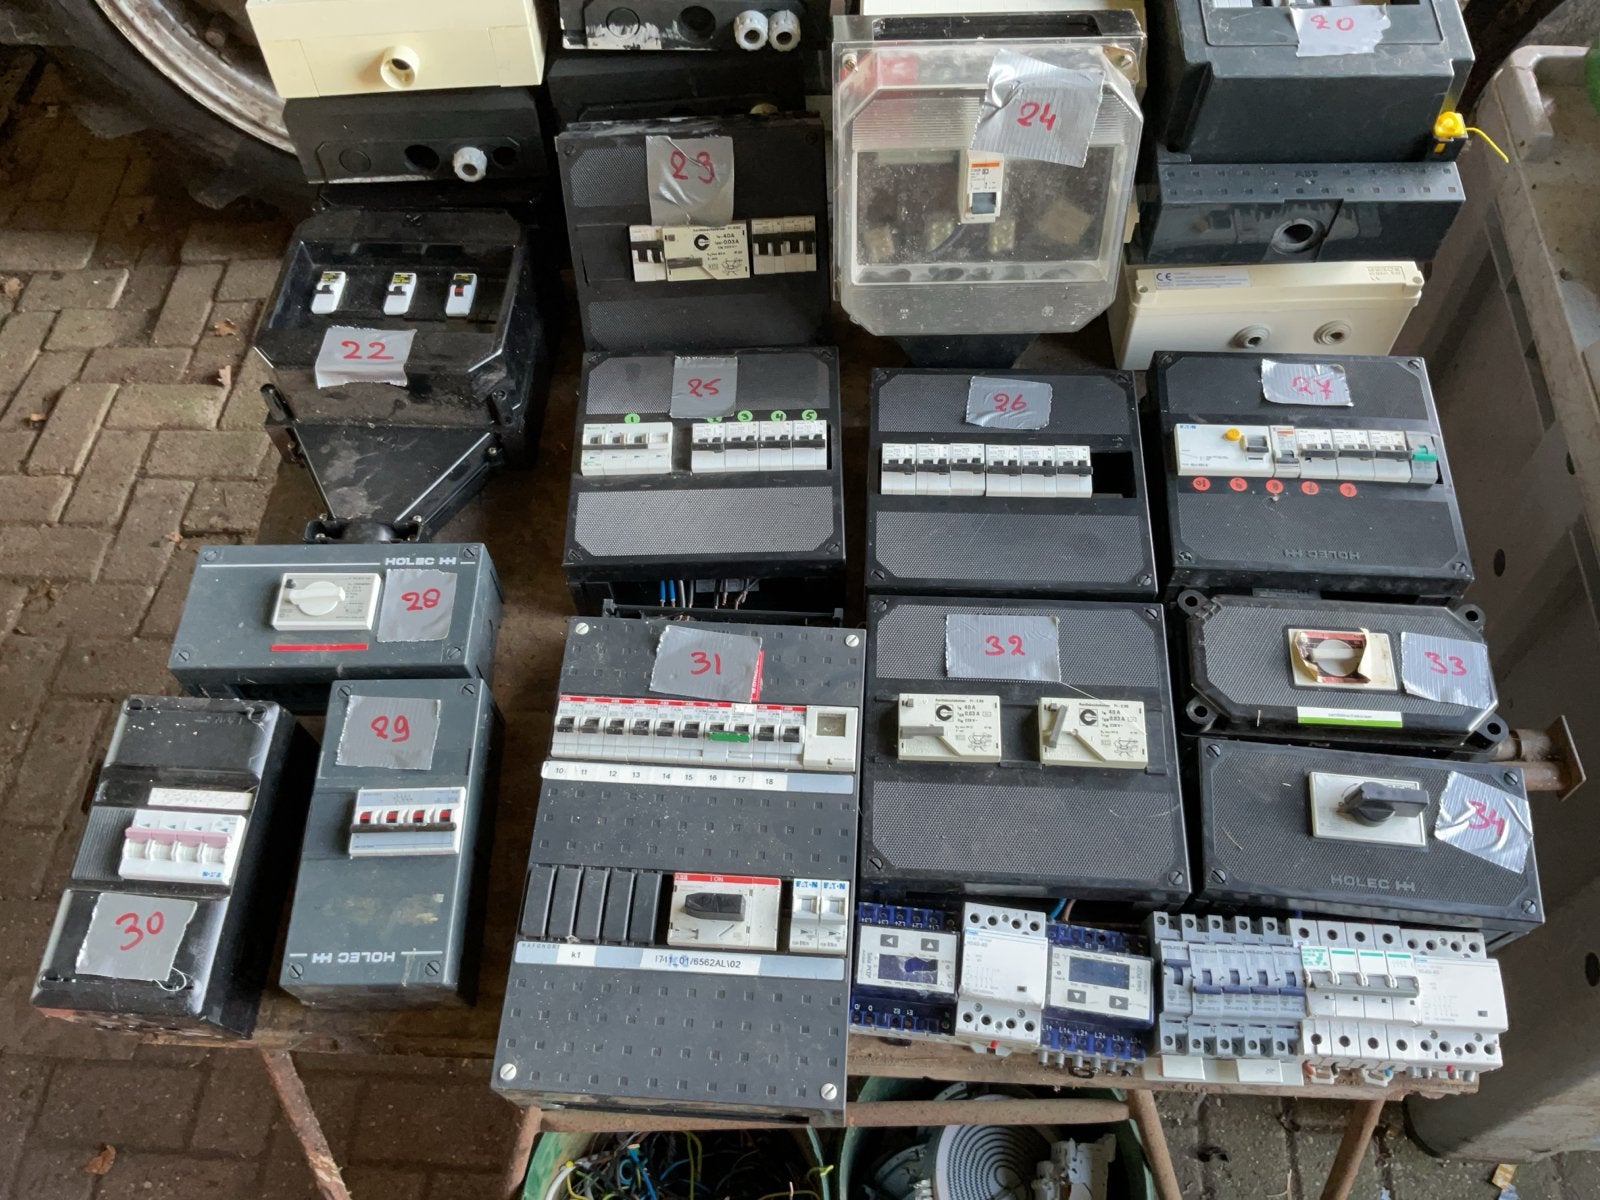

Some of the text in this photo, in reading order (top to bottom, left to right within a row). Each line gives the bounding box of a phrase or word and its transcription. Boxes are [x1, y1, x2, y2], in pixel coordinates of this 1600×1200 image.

[1310, 15, 1355, 31] 20
[1017, 102, 1056, 131] 24
[670, 149, 715, 184] 23
[341, 340, 394, 360] 22
[688, 378, 722, 397] 25
[1291, 376, 1334, 399] 27
[993, 393, 1027, 411] 26
[805, 411, 814, 420] 5
[384, 557, 436, 566] HOLEC
[401, 588, 441, 611] 28
[985, 635, 1026, 657] 32
[690, 651, 722, 676] 31
[1424, 651, 1467, 676] 33
[370, 714, 411, 743] 29
[684, 773, 694, 781] 15
[1466, 800, 1505, 838] 34
[823, 881, 846, 890] EATON
[1330, 874, 1390, 889] HOLEC
[115, 911, 164, 951] 30
[337, 951, 396, 963] HOLEC
